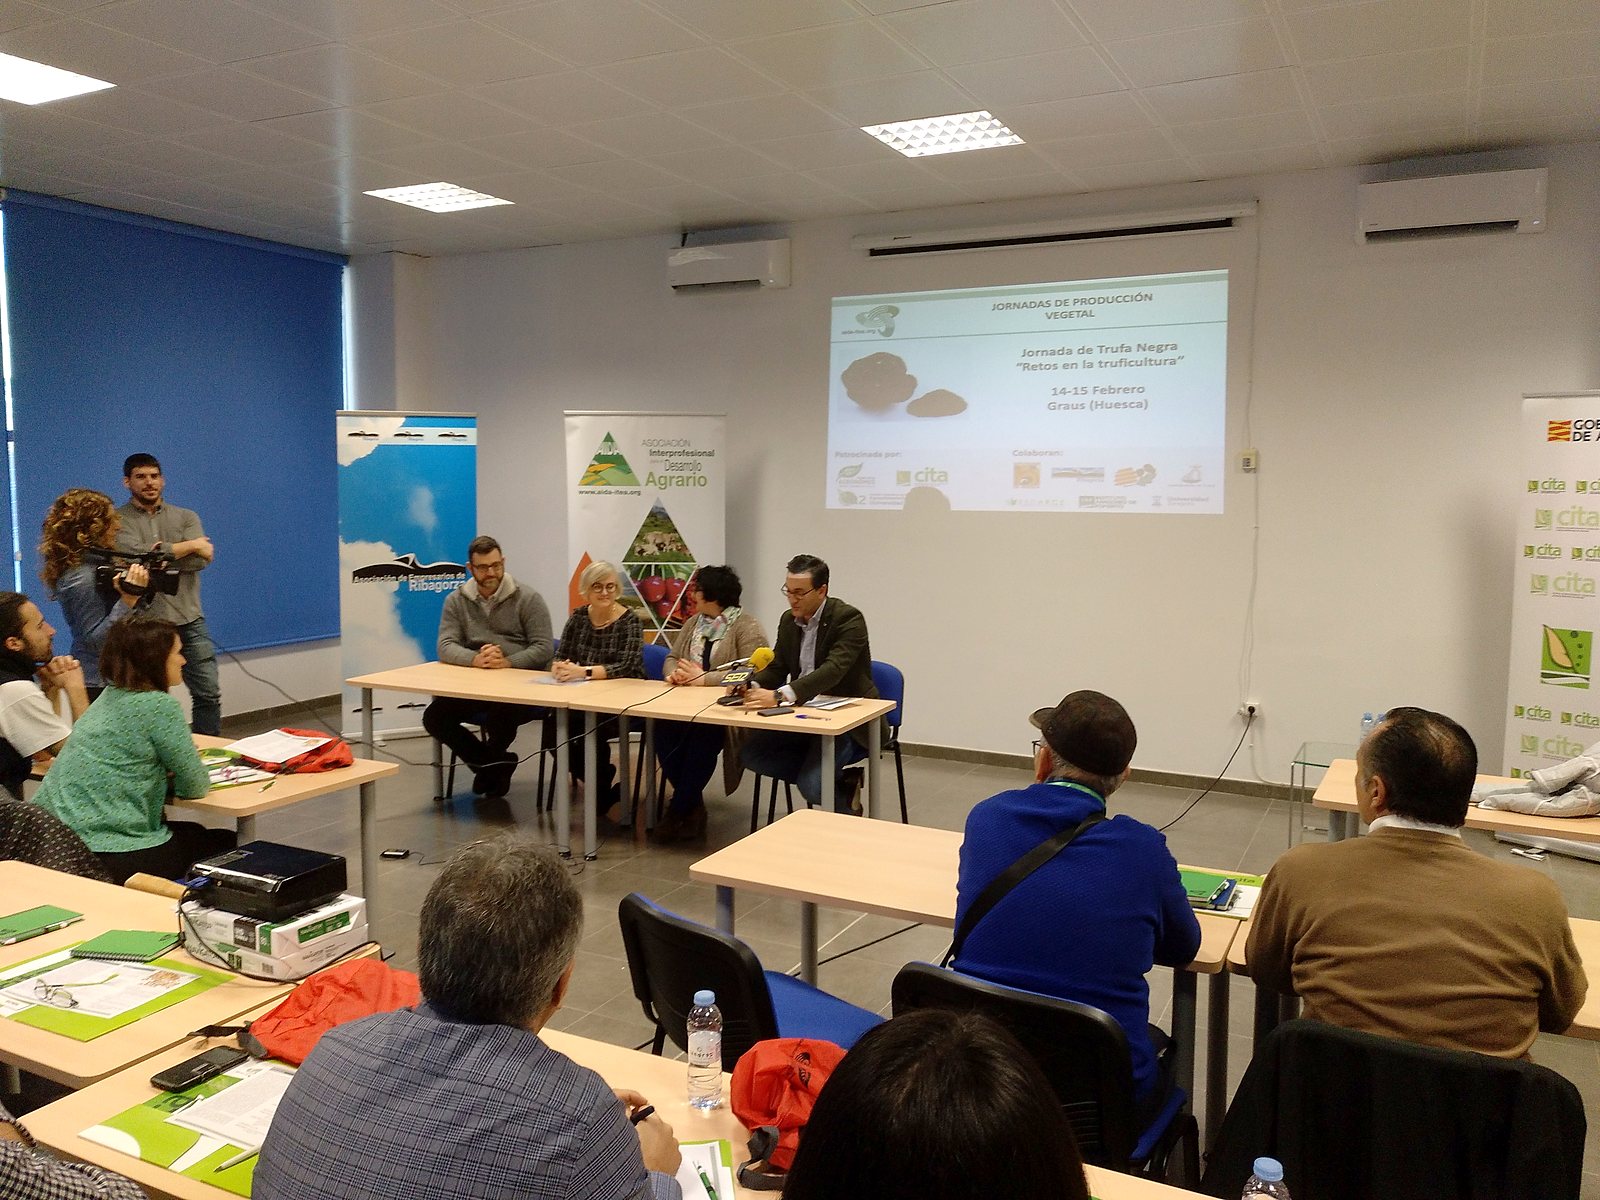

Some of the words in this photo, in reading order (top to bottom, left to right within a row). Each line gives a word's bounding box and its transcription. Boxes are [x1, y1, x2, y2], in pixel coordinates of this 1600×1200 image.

[991, 300, 1051, 311] JORNADAS
[1055, 299, 1070, 307] DE
[1073, 292, 1153, 306] PRODUCCIÓN
[1045, 309, 1095, 320] VEGETAL
[1021, 346, 1073, 358] Jornada
[1077, 346, 1094, 355] de
[1097, 343, 1133, 354] Trufa
[1136, 342, 1178, 353] Negra
[1062, 362, 1078, 370] en
[1082, 360, 1094, 369] la
[1051, 387, 1089, 396] 14-15
[1092, 385, 1146, 395] Febrero
[1047, 401, 1086, 411] Graus
[1090, 399, 1149, 411] (Huesca)
[642, 438, 691, 447] ASOCIACIÓN
[1573, 431, 1591, 441] DE
[649, 449, 715, 457] Interprofesional
[1012, 449, 1064, 457] Colaboran:
[664, 459, 702, 472] Desarrollo
[645, 471, 708, 490] Agrario
[914, 466, 949, 483] cita
[1541, 477, 1566, 491] cita
[1557, 505, 1600, 527] cita
[1536, 543, 1562, 557] cita
[354, 574, 397, 583] Asociación
[408, 572, 455, 582] Empresarios
[455, 572, 466, 580] de
[1552, 571, 1596, 593] cita
[721, 672, 750, 683] SER
[1526, 704, 1552, 719] cita
[1574, 711, 1600, 726] cita
[1543, 734, 1584, 757] cita
